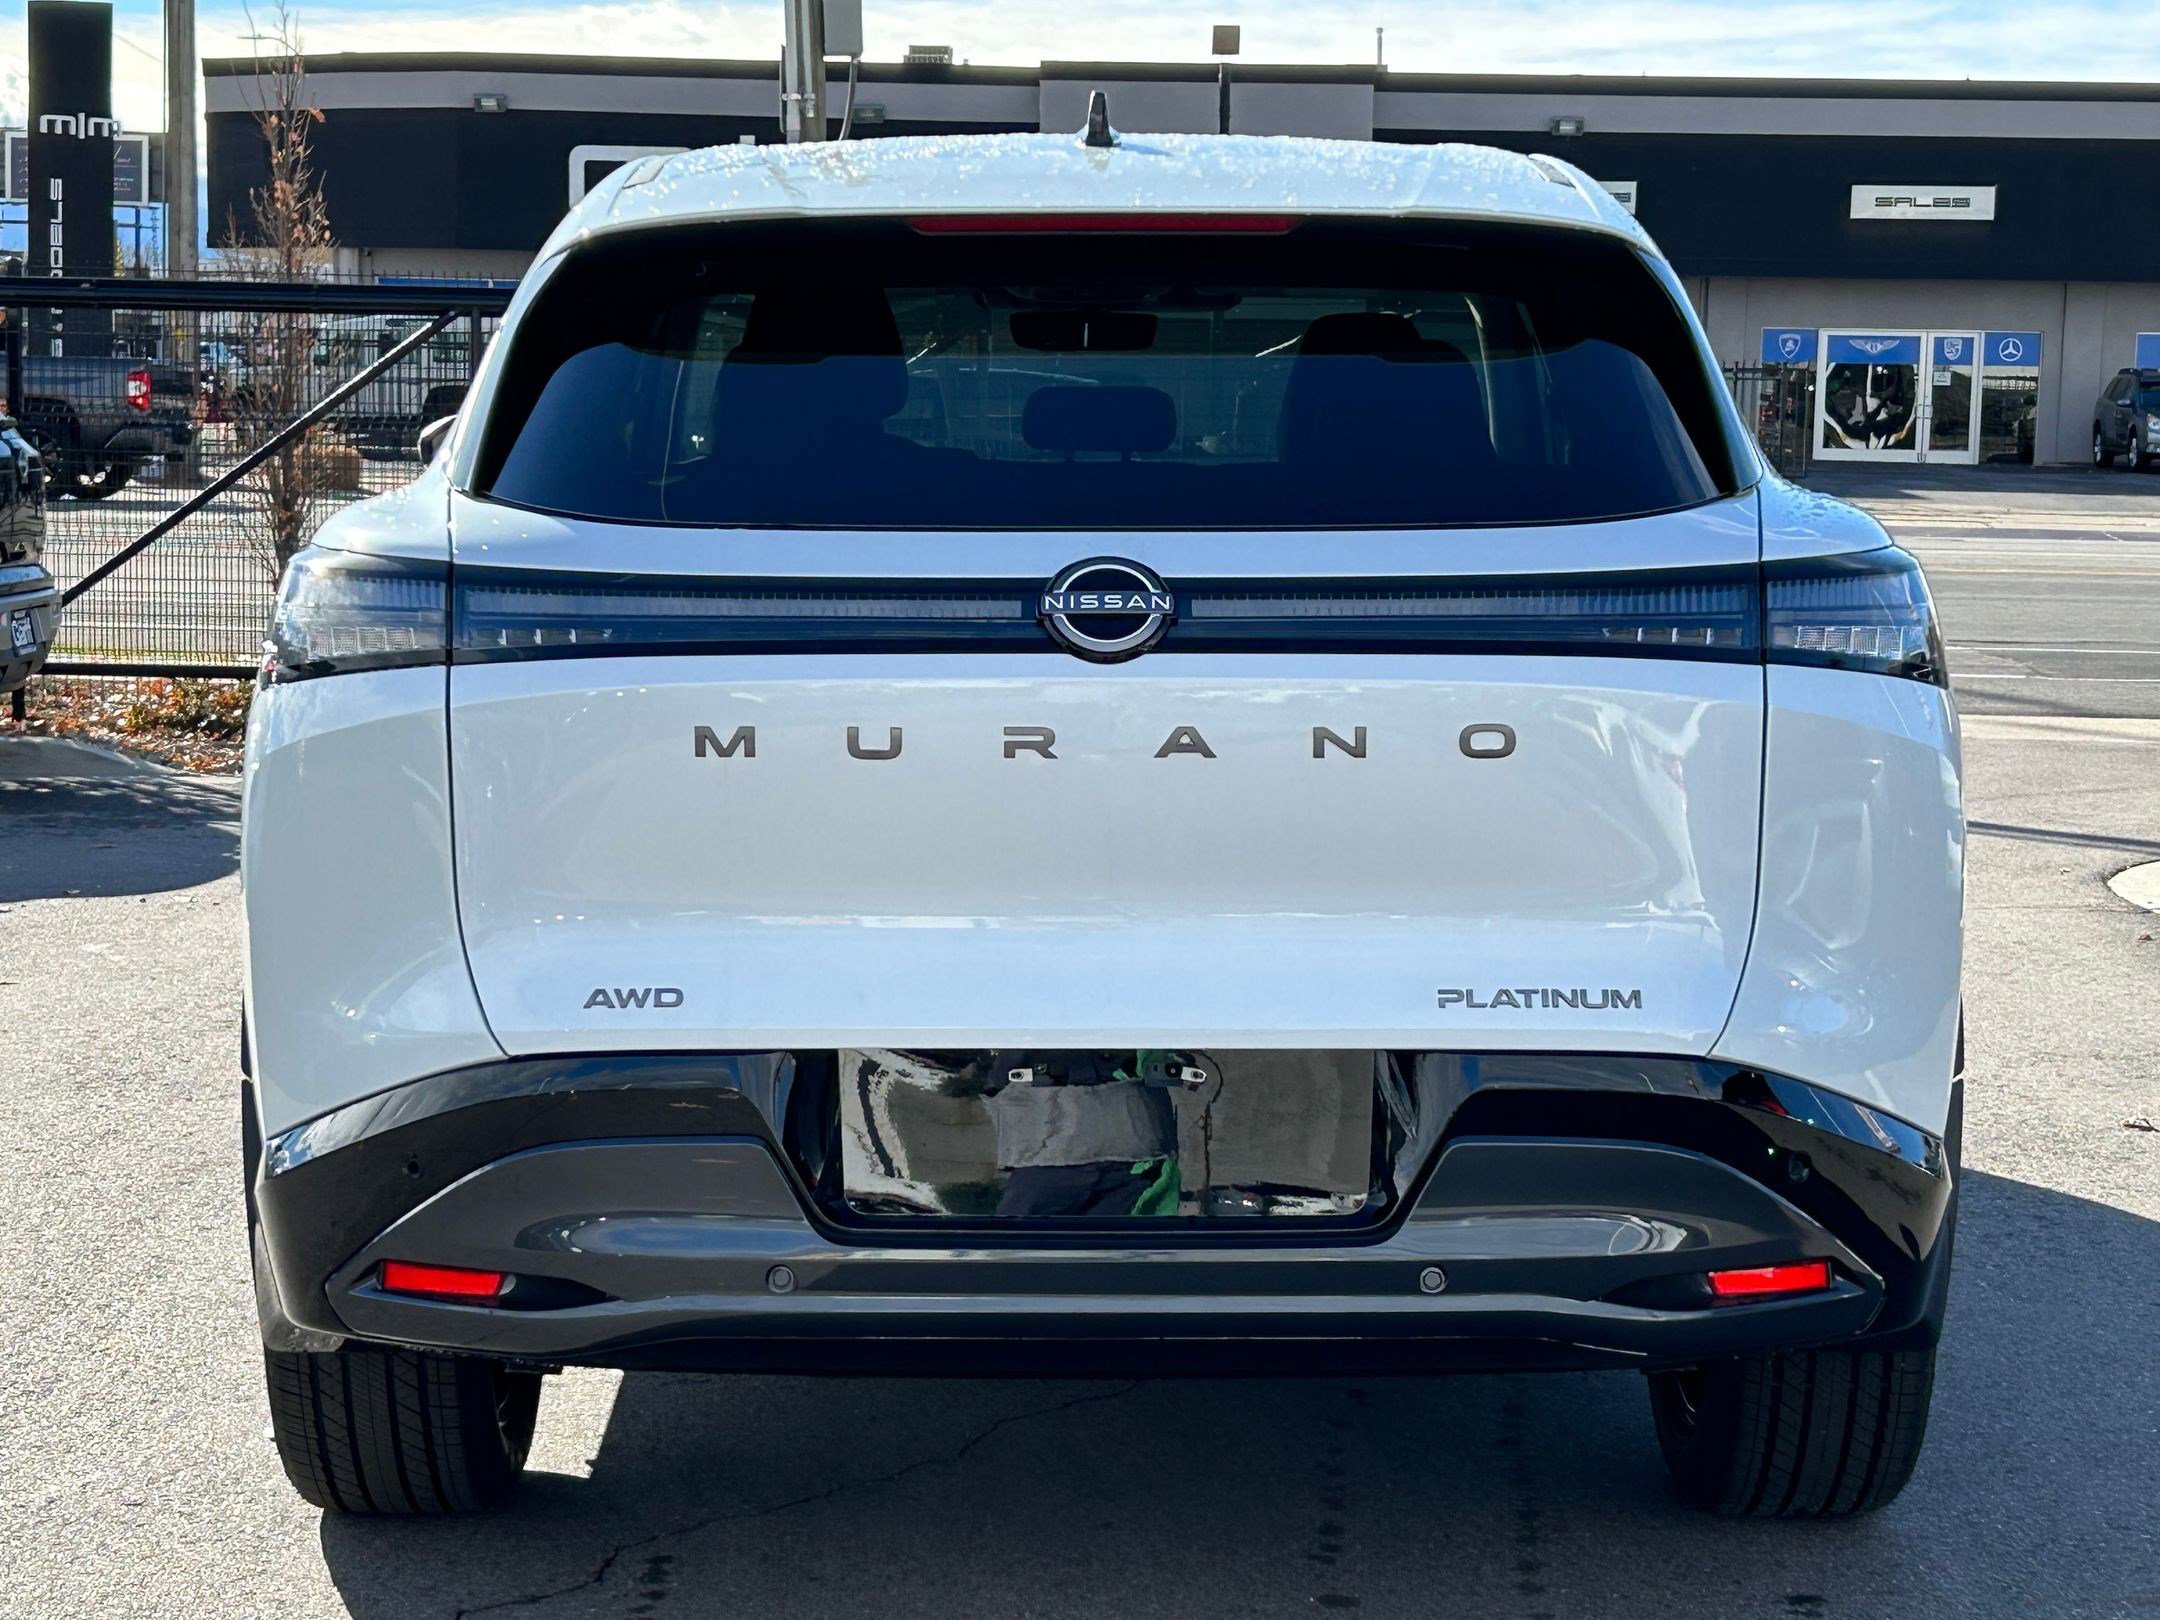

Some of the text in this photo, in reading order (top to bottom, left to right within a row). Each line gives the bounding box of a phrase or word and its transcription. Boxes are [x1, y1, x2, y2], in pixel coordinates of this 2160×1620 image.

[1875, 197, 1970, 207] SALES
[1044, 594, 1170, 610] NISSAN
[694, 723, 1517, 759] MURANO
[583, 988, 684, 1009] AWD
[1438, 988, 1642, 1009] PLATINUM
